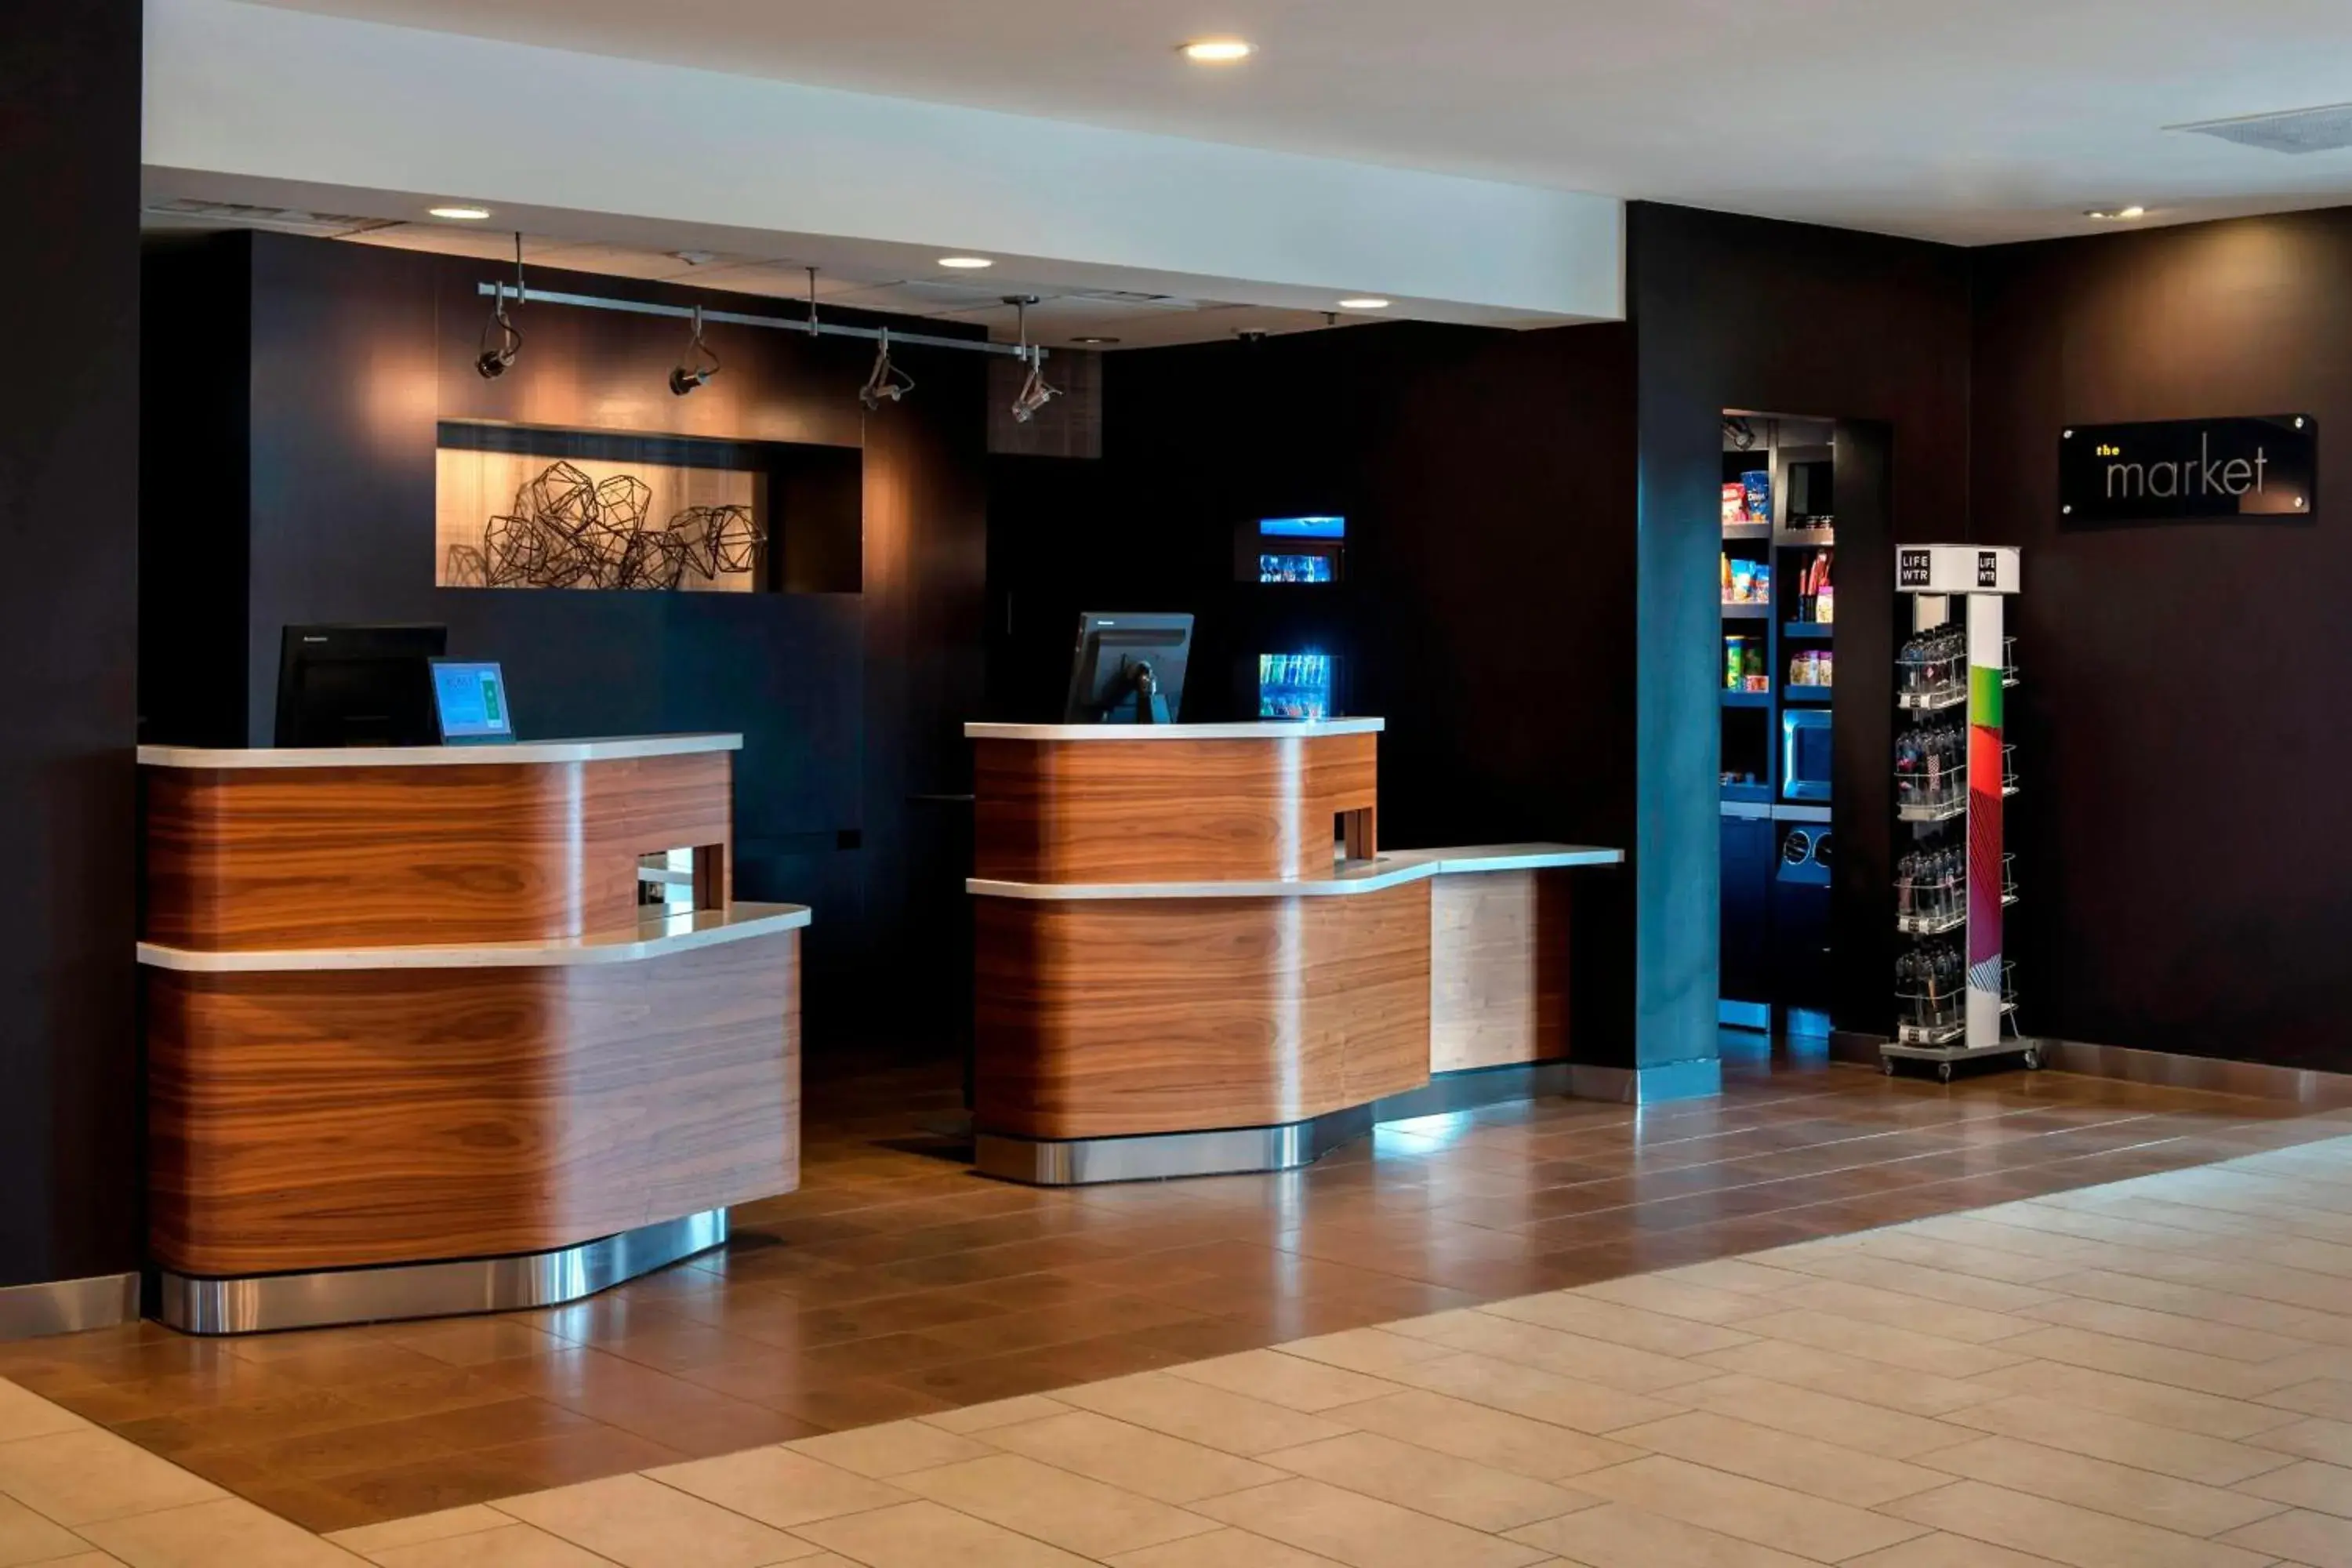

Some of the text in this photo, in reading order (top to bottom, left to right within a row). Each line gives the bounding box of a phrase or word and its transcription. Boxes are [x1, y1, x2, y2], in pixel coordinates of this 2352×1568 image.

[2096, 445, 2120, 456] the
[2107, 431, 2268, 499] market
[1903, 555, 1929, 567] LIFE
[1903, 570, 1929, 580] WTR
